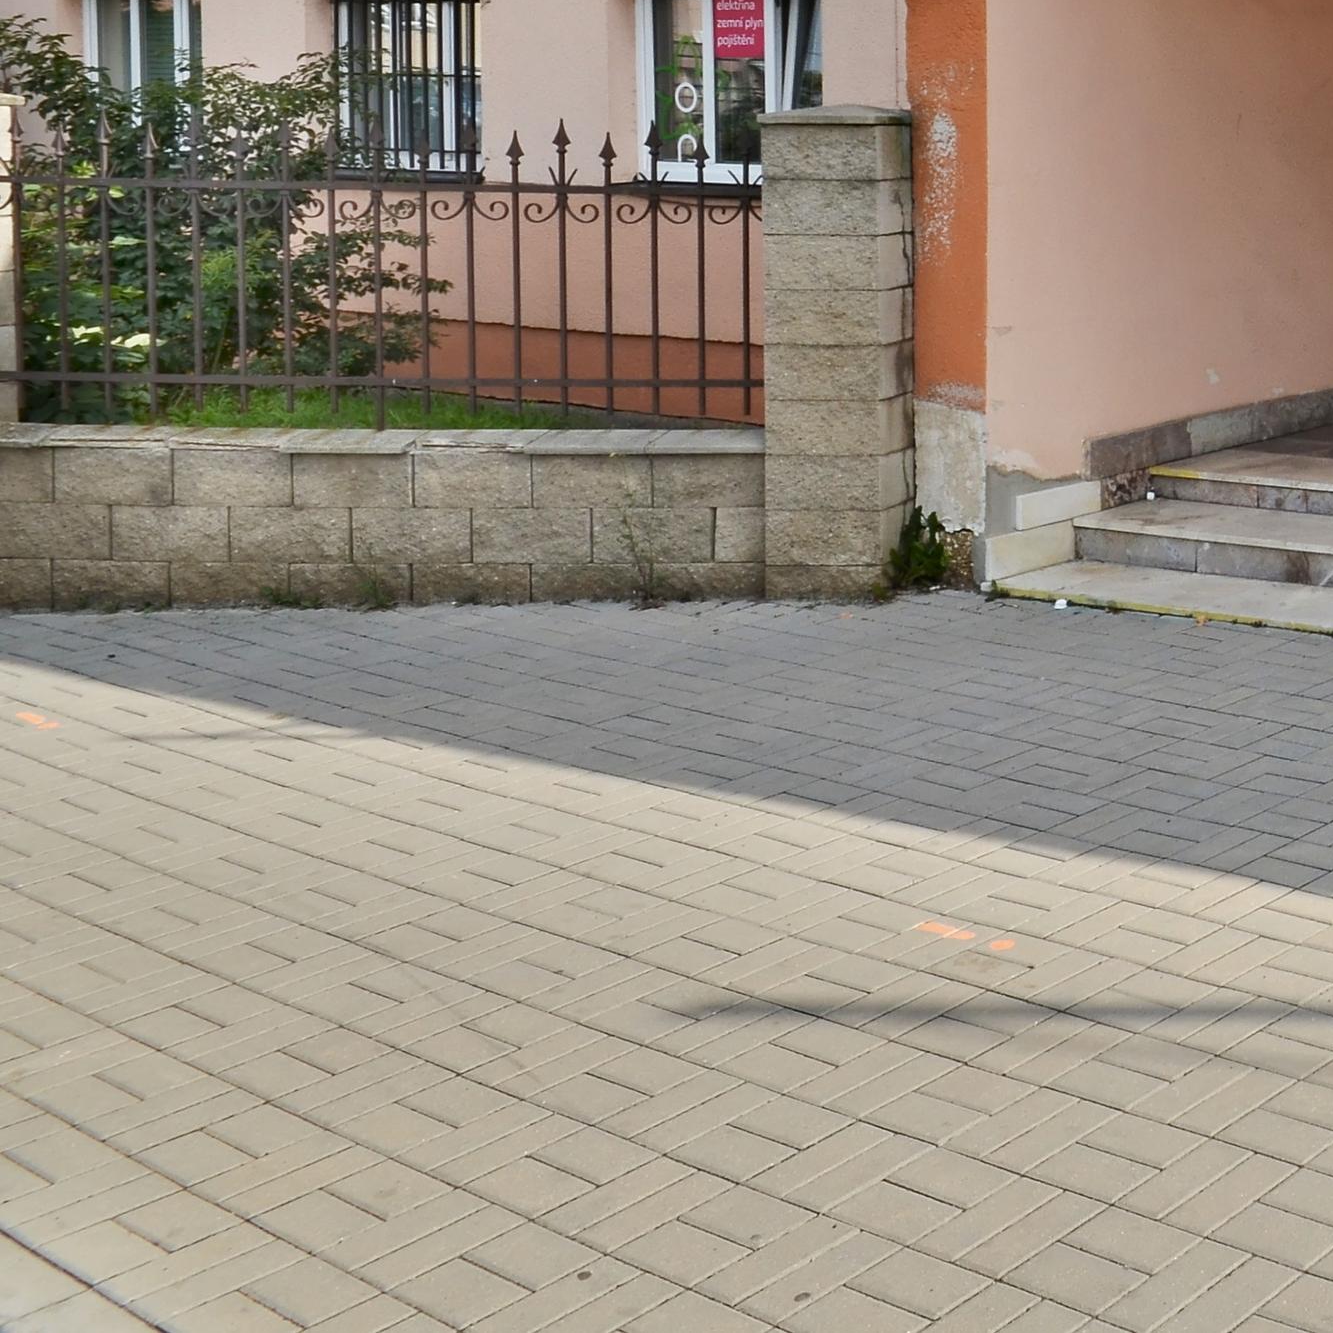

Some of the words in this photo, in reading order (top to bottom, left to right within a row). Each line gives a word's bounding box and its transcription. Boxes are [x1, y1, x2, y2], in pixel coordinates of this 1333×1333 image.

[717, 17, 744, 28] zemní
[745, 16, 764, 31] plyn
[717, 33, 755, 48] pojištění
